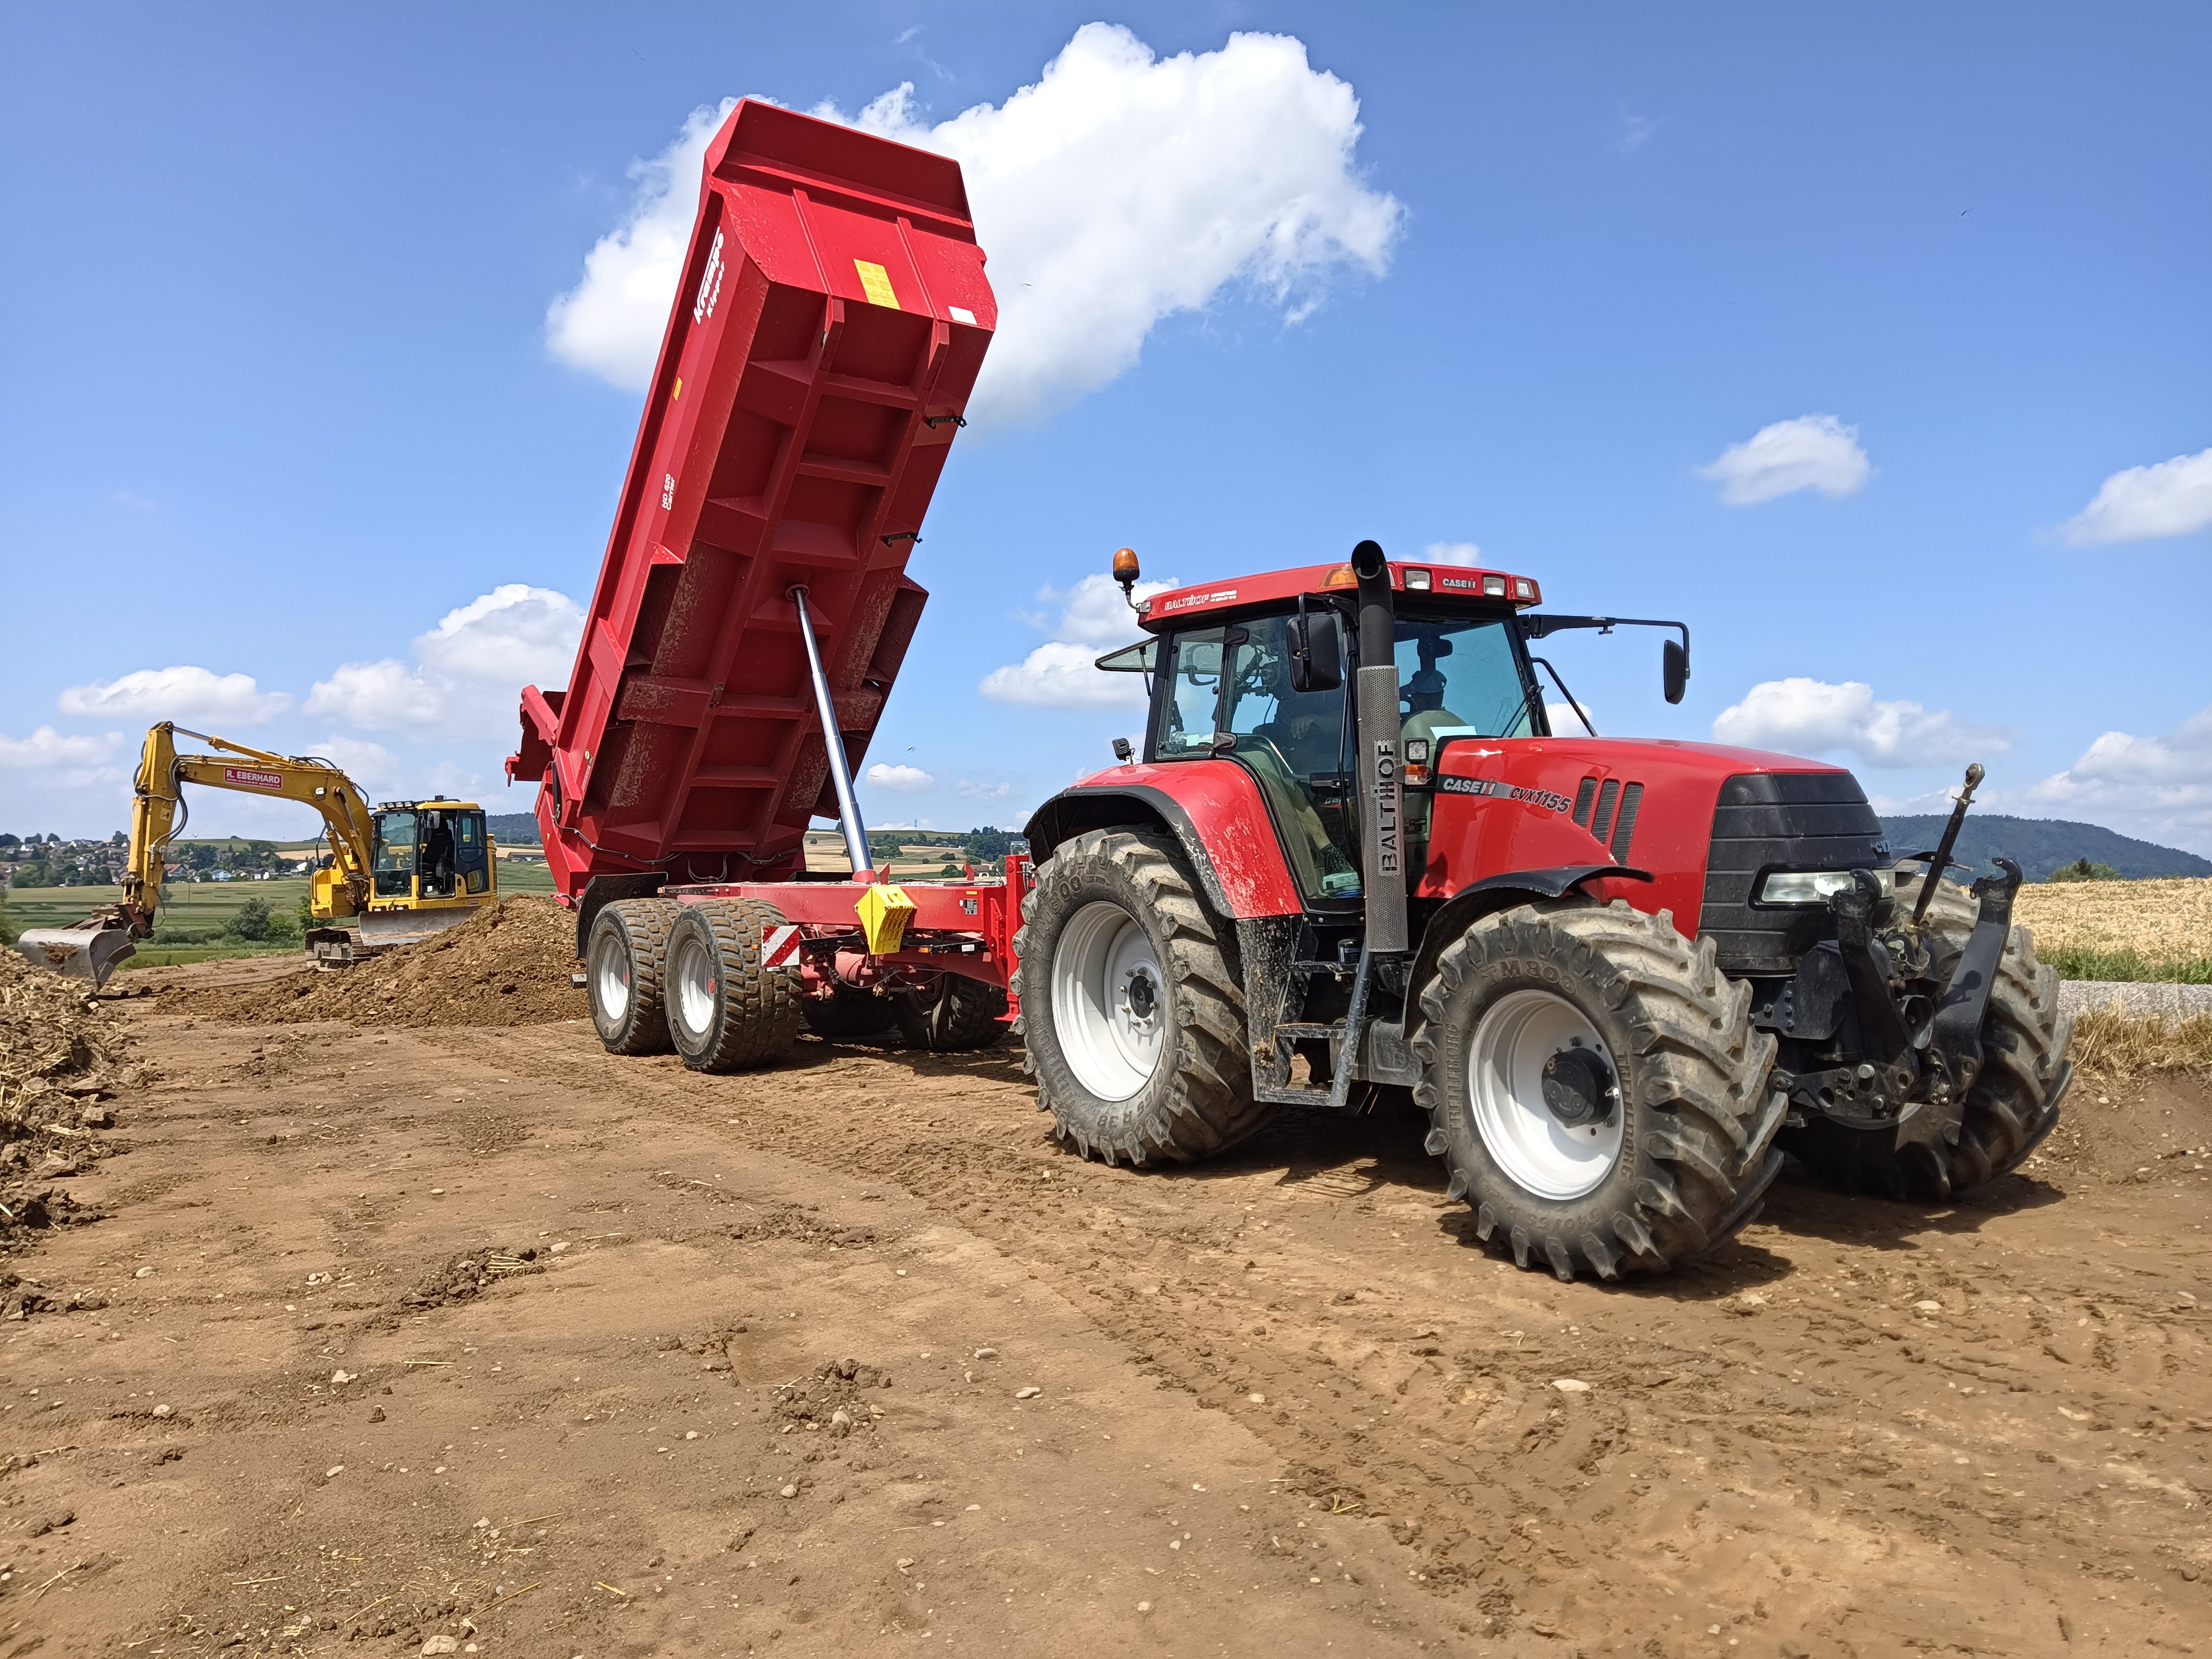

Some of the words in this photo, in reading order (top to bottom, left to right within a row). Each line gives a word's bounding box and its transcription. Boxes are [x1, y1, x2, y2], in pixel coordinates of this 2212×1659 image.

[226, 769, 235, 778] R.
[236, 771, 281, 784] EBERHARD
[1509, 786, 1573, 814] CVX1155
